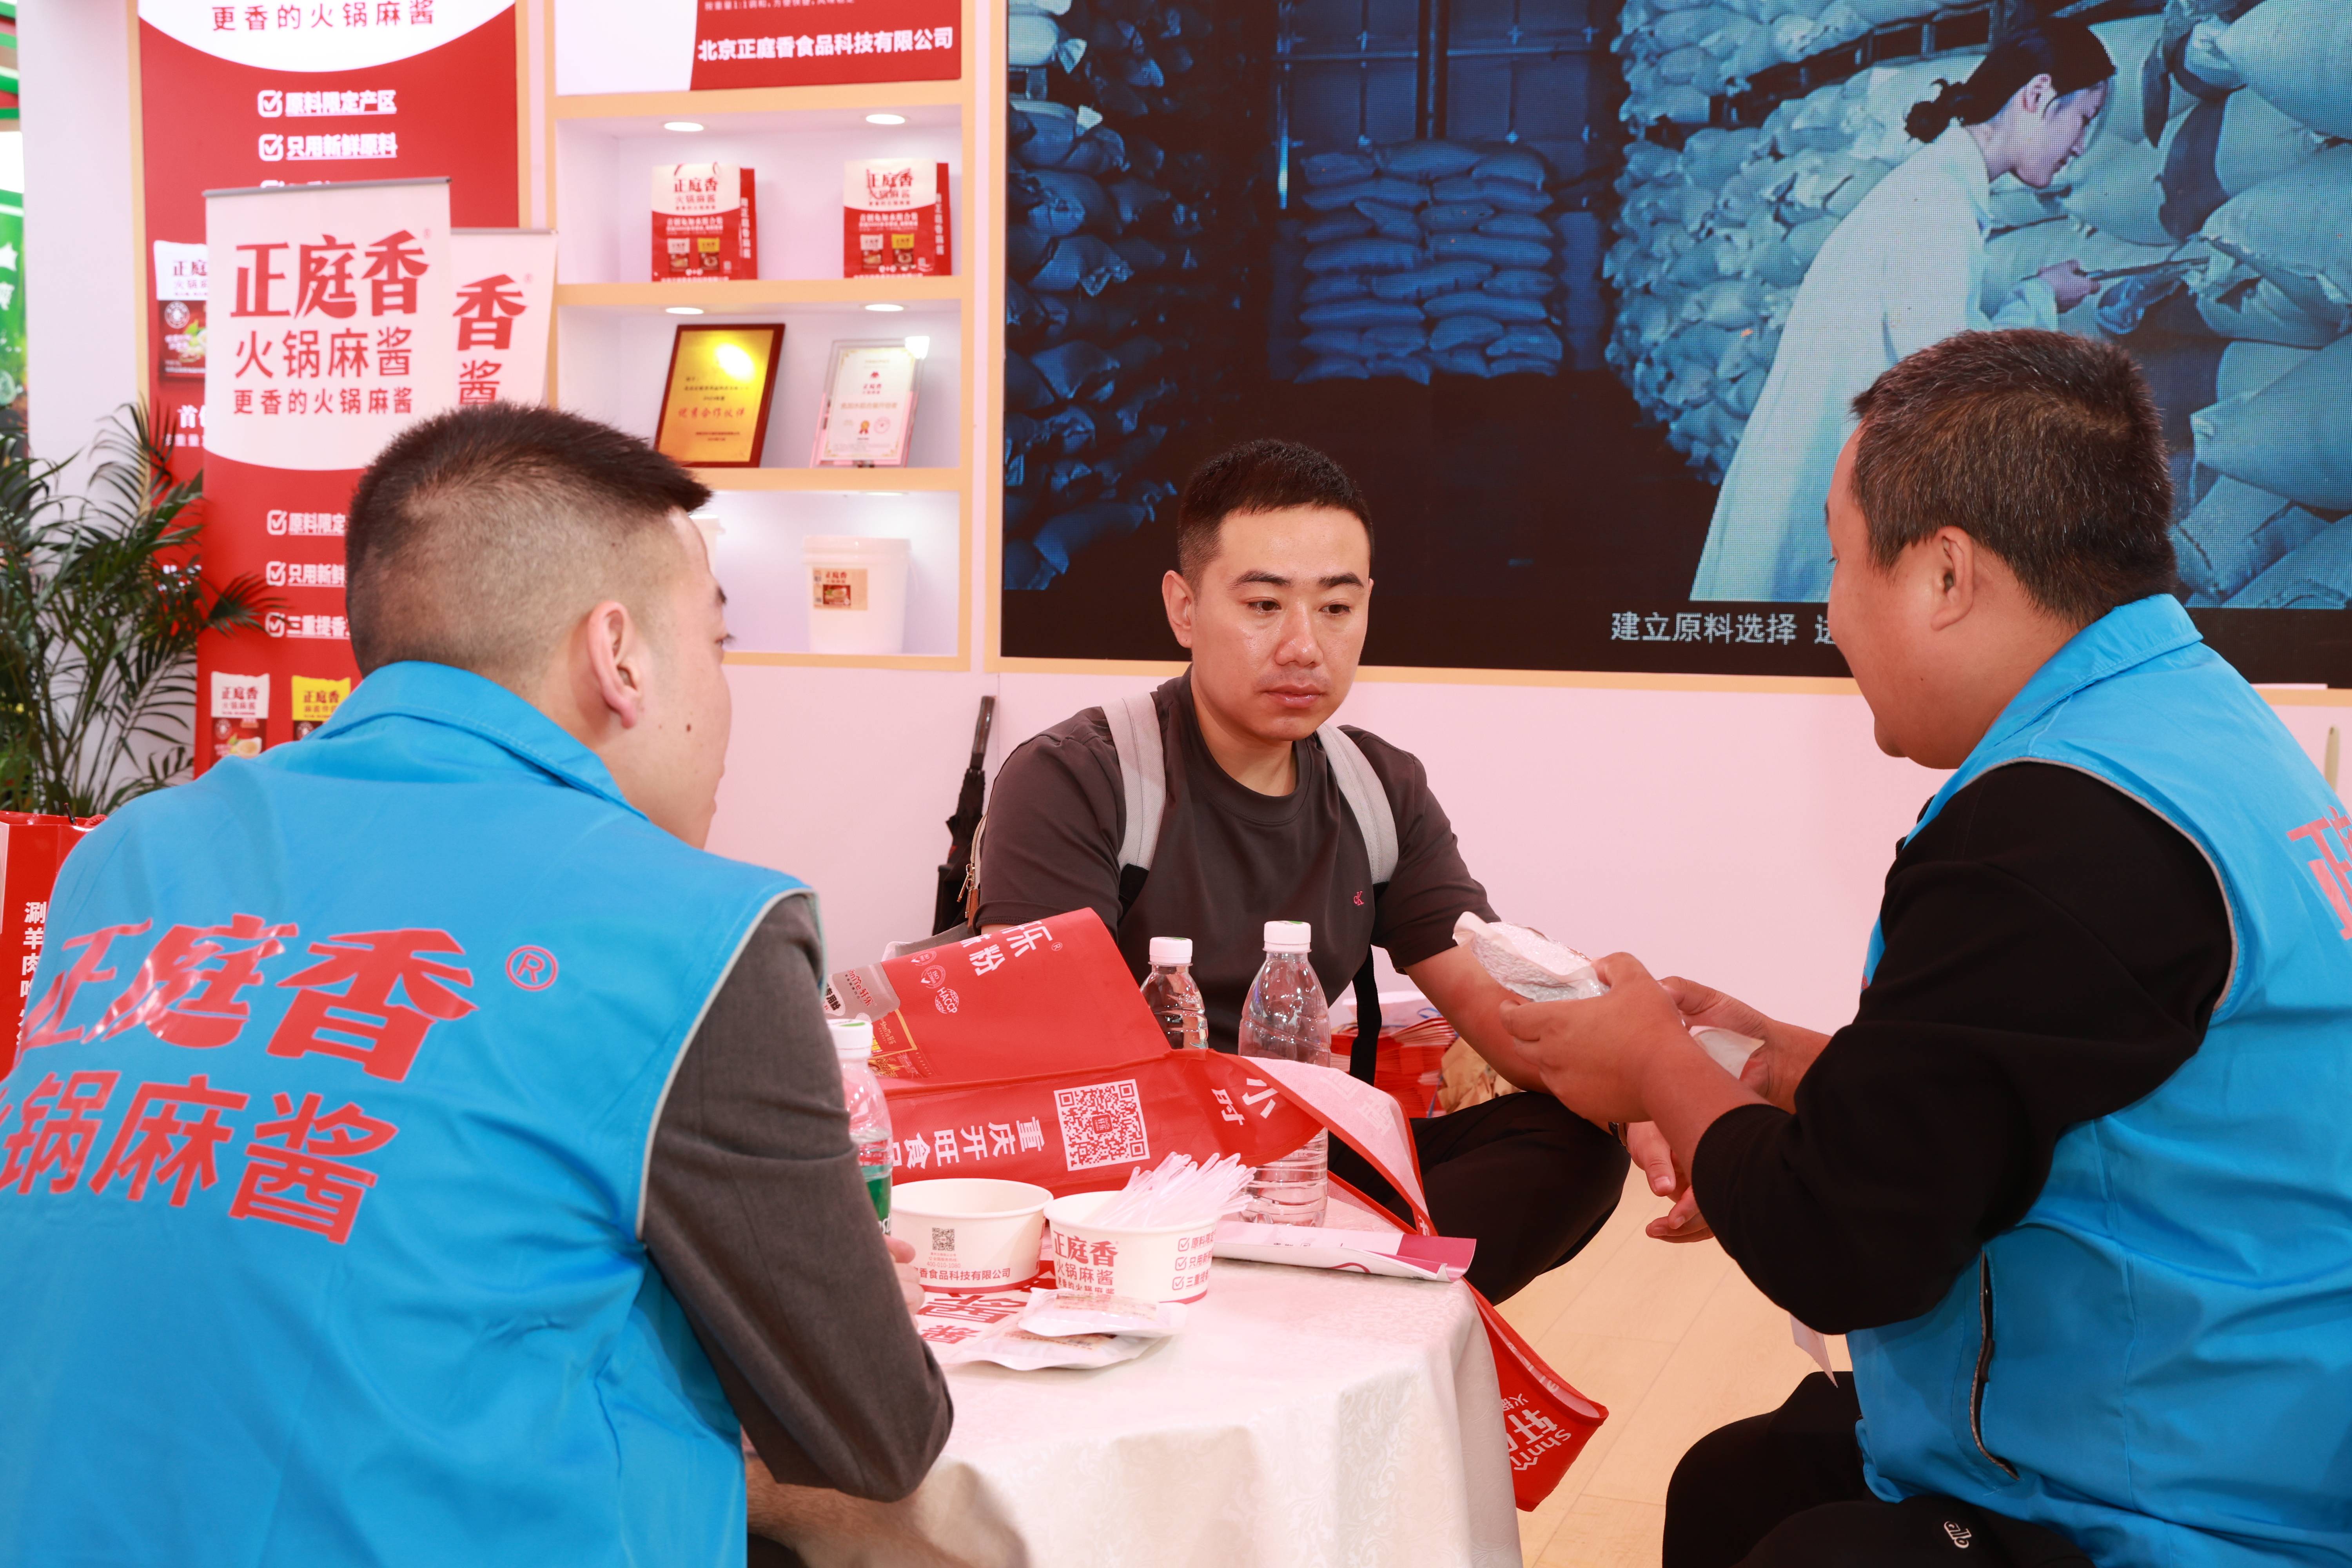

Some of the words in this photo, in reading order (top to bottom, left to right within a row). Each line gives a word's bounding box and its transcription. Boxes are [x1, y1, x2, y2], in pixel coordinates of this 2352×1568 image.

[212, 0, 434, 31] 更香的火锅麻酱
[698, 27, 953, 61] 北京正庭香食品科技有限公司
[285, 90, 397, 114] 原料限定产区
[287, 132, 397, 158] 只用新鲜原料
[674, 177, 718, 192] 正庭香
[230, 229, 430, 320] 正庭香
[453, 274, 528, 351] 香
[235, 326, 412, 379] 火锅麻酱
[458, 360, 502, 406] 酱
[233, 386, 412, 415] 更香的火锅麻酱
[286, 615, 350, 637] 三重提香
[1611, 612, 1797, 645] 建立原料选择
[222, 686, 258, 699] 正庭香
[927, 971, 936, 984] 22000
[14, 913, 480, 1082] 正庭香
[936, 987, 958, 1013] HACCP
[0, 1070, 399, 1244] 锅麻酱
[1054, 1230, 1119, 1267] 正庭香
[914, 1267, 1011, 1281] 香食品科技有限公司
[1057, 1259, 1114, 1285] 火锅麻酱
